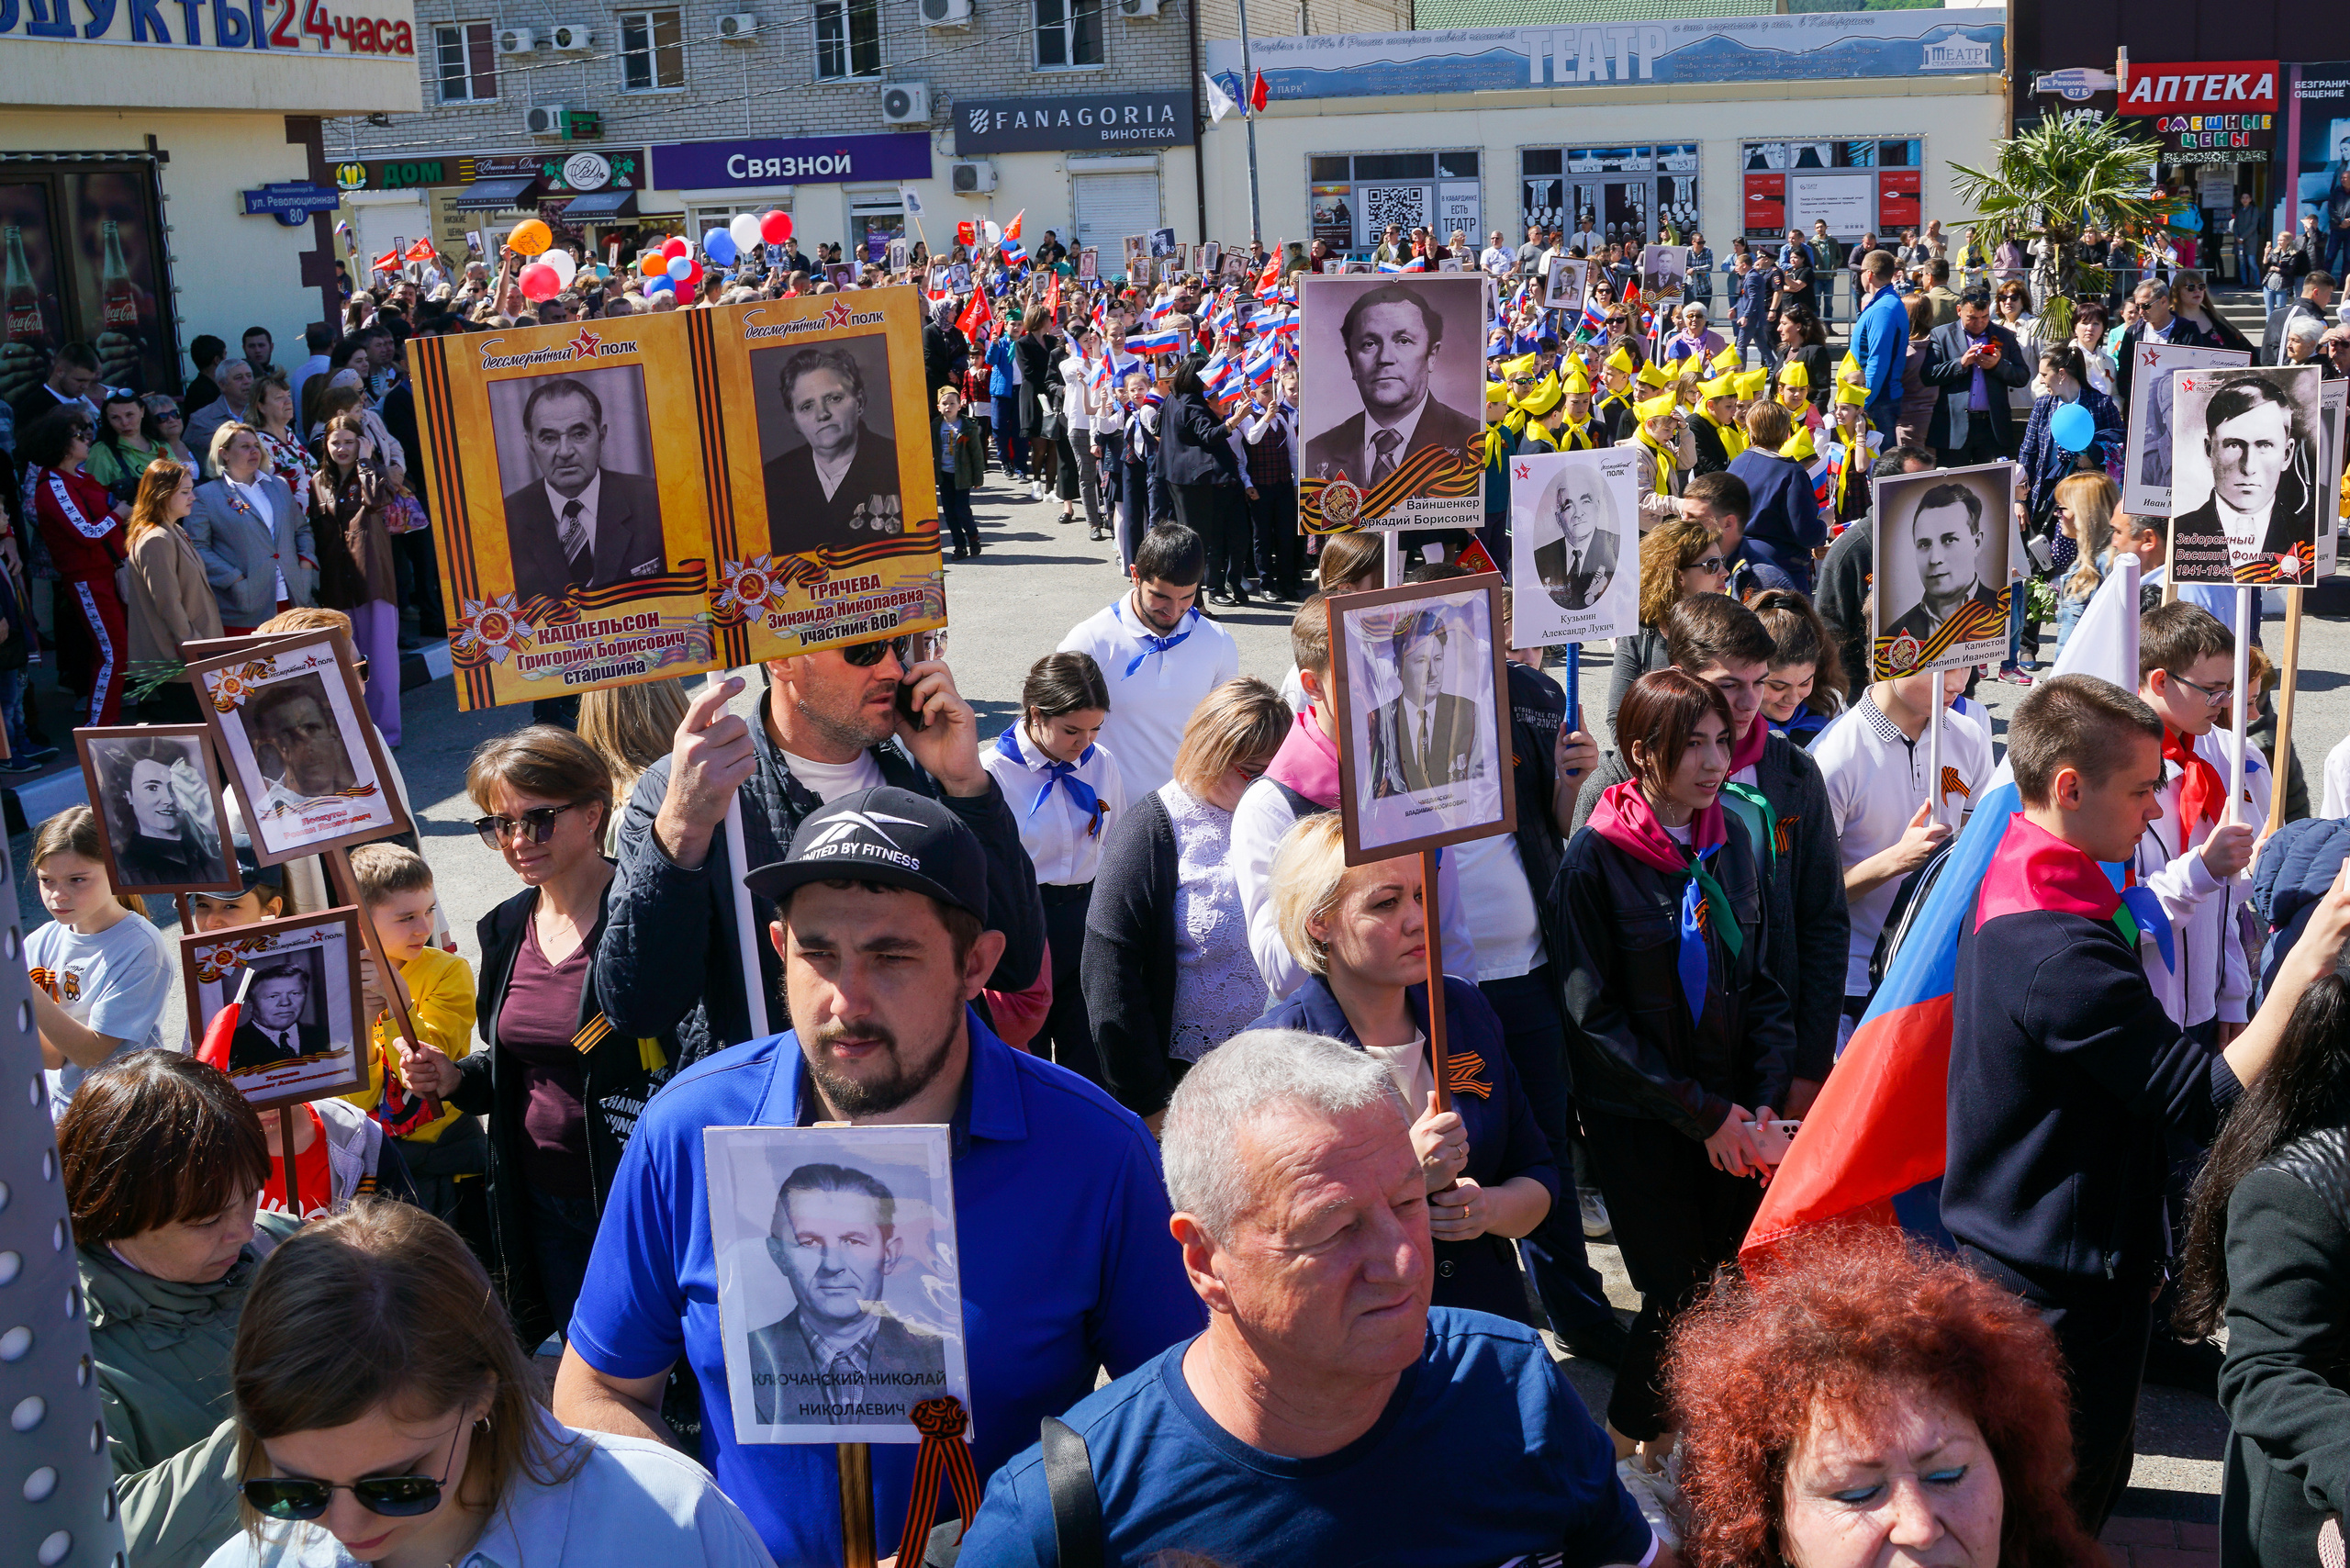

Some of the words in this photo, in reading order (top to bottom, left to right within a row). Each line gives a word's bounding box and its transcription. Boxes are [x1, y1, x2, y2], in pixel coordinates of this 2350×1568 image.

[1683, 23, 1704, 31] это
[1706, 20, 1759, 32] случилось
[1807, 15, 1875, 30] Кабардинке
[1347, 35, 1383, 49] России
[1385, 36, 1432, 48] построен
[1434, 31, 1467, 43] новый
[1470, 29, 1516, 41] частный
[1521, 26, 1668, 84] ТЕАТР
[1931, 47, 1984, 61] ТЕАТР
[2067, 88, 2080, 96] 67
[2081, 88, 2089, 96] Б
[2128, 73, 2274, 103] АПТЕКА
[2294, 89, 2344, 99] ОБЩЕНИЕ
[996, 105, 1175, 129] FANAGORIA
[2062, 107, 2104, 122] КАФЕ
[2157, 114, 2272, 132] СМЕШНЫЕ
[1101, 128, 1175, 140] ВИНОТЕКА
[2181, 131, 2250, 149] ЦЕНЫ
[383, 162, 443, 189] ДОМ
[252, 198, 266, 210] ул.
[267, 196, 336, 207] Революционная
[1446, 194, 1478, 202] КАБАРДИНКЕ
[289, 208, 304, 222] 80
[1450, 204, 1469, 215] ЕСТЬ
[444, 215, 466, 224] НИЗКИЕ
[1443, 218, 1476, 232] ТЕАТР
[447, 228, 465, 237] ЦЕНЫ
[1606, 469, 1625, 477] ПОЛК
[1406, 498, 1480, 510] Вайншенкер
[2143, 498, 2165, 507] Иван
[1359, 515, 1410, 528] Аркадий
[1414, 513, 1480, 525] Борисович
[2176, 532, 2255, 547] Задорожный
[2176, 549, 2229, 561] Василий
[2232, 550, 2275, 561] Фомич
[2176, 565, 2234, 577] 1941-1945
[809, 574, 881, 601] ГРЯЧЕВА
[767, 606, 835, 631] Зинаида
[836, 588, 924, 622] Николаевна
[1561, 613, 1596, 624] Кузьмин
[537, 611, 660, 644] КАЦНЕЛЬСОН
[800, 620, 869, 647] участник
[870, 612, 899, 633] ВОВ
[1541, 626, 1587, 639] Александр
[1588, 622, 1615, 634] Лукич
[517, 644, 595, 670] Григорий
[596, 632, 687, 659] Борисович
[1964, 638, 2006, 651] Калистов
[1925, 657, 1961, 668] Филипп
[1962, 650, 2006, 663] Иванович
[564, 660, 646, 685] старшина
[1404, 805, 1434, 817] ВЛАДИМИР
[1435, 799, 1468, 811] ИОСИФОВИЧ
[283, 826, 317, 839] Роман
[318, 812, 372, 832] Яковлевич
[301, 810, 348, 826] Лоскутов
[841, 842, 860, 855] BY
[862, 843, 921, 871] FITNESS
[753, 1371, 866, 1387] КЛЮЧАНСКИЙ
[871, 1371, 947, 1386] НИКОЛАЙ
[799, 1403, 906, 1417] НИКОЛАЕВИЧ
